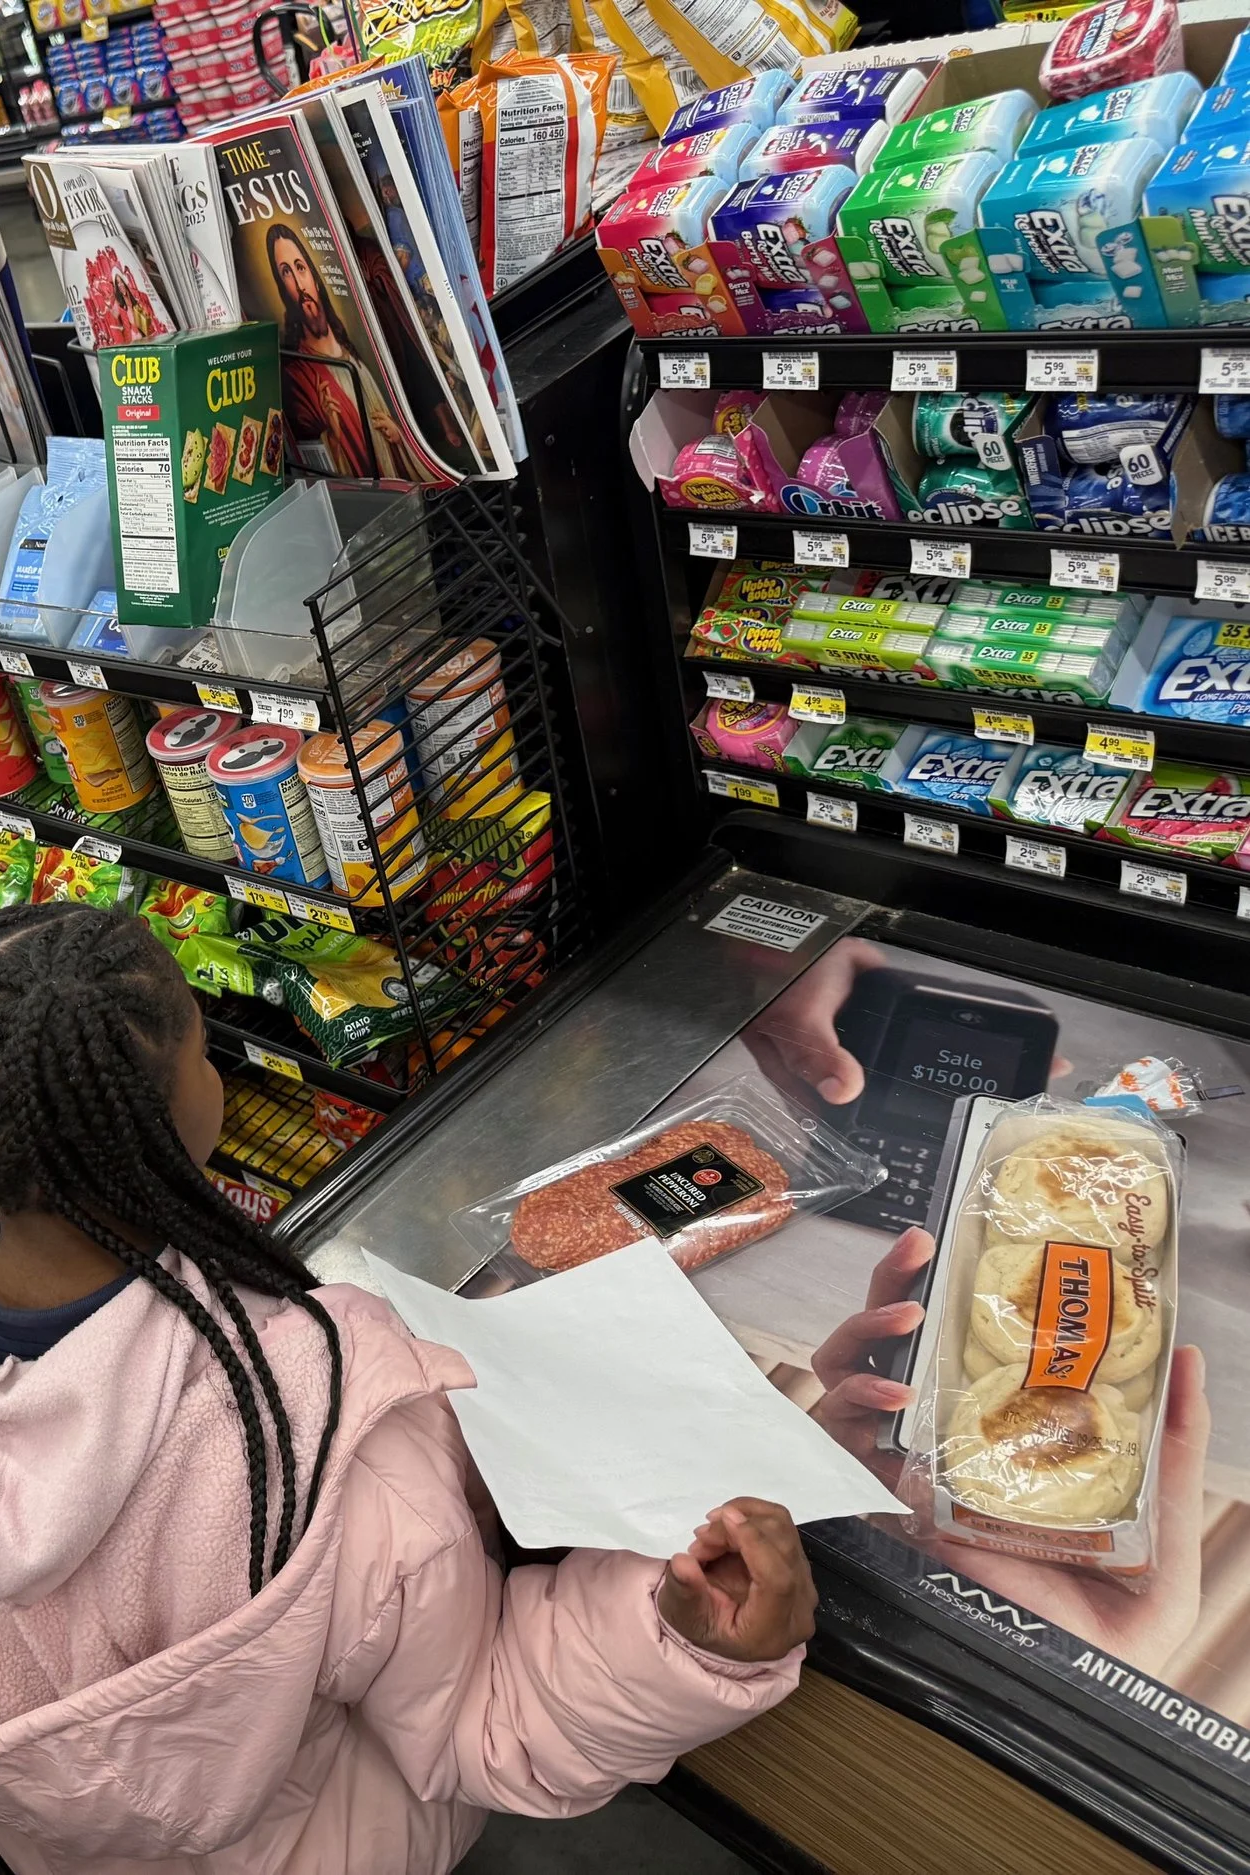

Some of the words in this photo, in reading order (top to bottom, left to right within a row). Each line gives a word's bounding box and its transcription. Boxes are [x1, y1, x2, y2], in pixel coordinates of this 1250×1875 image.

[500, 105, 541, 118] Nutrition
[542, 102, 564, 114] Facts
[500, 135, 525, 145] Calories
[533, 131, 547, 141] 160
[549, 128, 564, 139] 450
[222, 141, 270, 176] TIME
[29, 163, 58, 220] O
[224, 169, 311, 225] ESUS
[184, 212, 206, 228] 2025
[869, 220, 910, 277] Refreshers
[883, 217, 939, 277] Extra
[1014, 214, 1059, 275] Refreshers
[1030, 210, 1090, 273] Extra
[756, 222, 808, 284] Extra
[640, 237, 692, 289] Extra
[728, 281, 750, 291] Berry
[207, 353, 236, 366] WELCOME
[236, 349, 252, 360] YOUR
[111, 354, 161, 387] CLUB
[122, 386, 152, 396] SNACK
[206, 366, 256, 413] CLUB
[122, 395, 153, 405] STACKS
[125, 409, 151, 419] Original
[115, 439, 146, 447] Nutrition
[147, 439, 169, 447] Facts
[982, 440, 1001, 457] 60
[116, 465, 144, 473] Calories
[158, 463, 171, 473] 70
[1023, 447, 1041, 486] WINTERFROST
[1127, 453, 1150, 473] 60
[1131, 468, 1155, 480] PIECES
[688, 483, 720, 497] Hubba
[780, 484, 886, 521] Orbit
[907, 500, 1022, 525] eclipse
[1044, 510, 1172, 536] clipse
[742, 577, 776, 594] Hubba
[747, 588, 781, 602] Bubba
[840, 600, 876, 612] Extra
[881, 604, 892, 614] 35
[1004, 591, 1043, 605] Extra
[1049, 596, 1061, 607] 35
[828, 629, 863, 641] Extra
[868, 632, 879, 641] 35
[990, 619, 1031, 632] Extra
[1036, 623, 1049, 634] 35
[1222, 624, 1242, 638] 35
[825, 649, 840, 660] 35
[840, 650, 879, 664] STICKS
[977, 646, 1017, 661] Extra
[1022, 651, 1035, 662] 35
[975, 668, 991, 678] 35
[993, 670, 1036, 683] STICKS
[907, 754, 1004, 781] Extra
[1022, 770, 1128, 802] Extra
[1130, 788, 1250, 817] Extra
[740, 897, 819, 924] CAUTION
[725, 911, 740, 919] BELT
[740, 913, 760, 923] MOVES
[760, 917, 807, 935] AUTOMATICALLY
[727, 923, 743, 931] KEEP
[743, 927, 764, 937] HANDS
[764, 932, 784, 942] CLEAR
[344, 1016, 371, 1033] OTATO
[349, 1026, 371, 1041] CHIPS
[937, 1049, 983, 1070] Sale
[911, 1064, 998, 1093] $150.00
[658, 1174, 700, 1208] PEPPERONI
[669, 1172, 707, 1202] UNCURED
[1117, 1192, 1159, 1315] Easy-to-Split
[919, 1578, 1036, 1648] messagewrap
